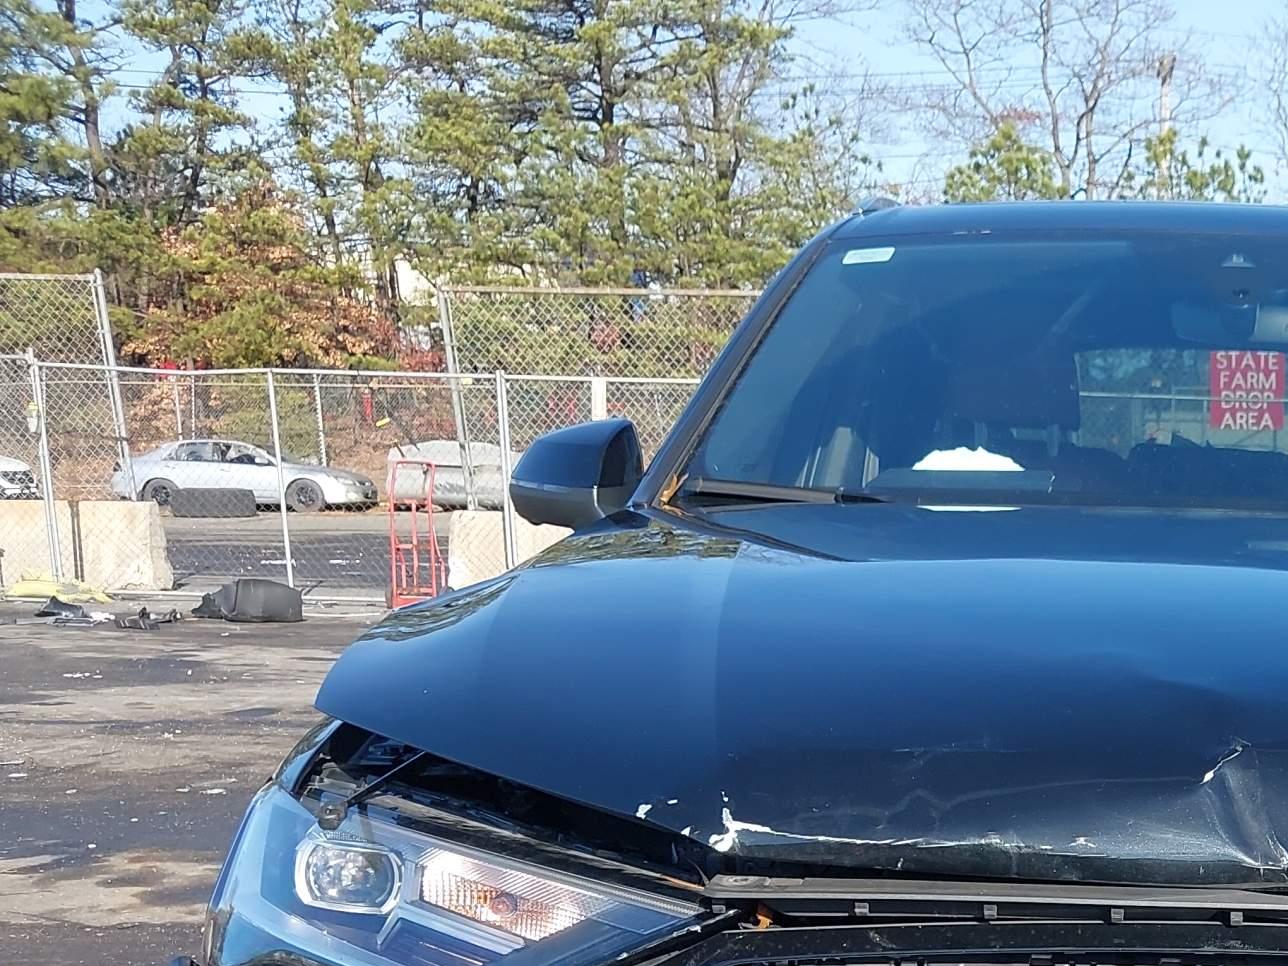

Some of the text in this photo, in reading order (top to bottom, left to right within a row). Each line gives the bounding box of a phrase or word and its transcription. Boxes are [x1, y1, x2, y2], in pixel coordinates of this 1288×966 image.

[1216, 350, 1280, 370] STATE
[1219, 371, 1277, 390] FARM
[1220, 391, 1275, 410] DROP
[1220, 412, 1274, 431] AREA
